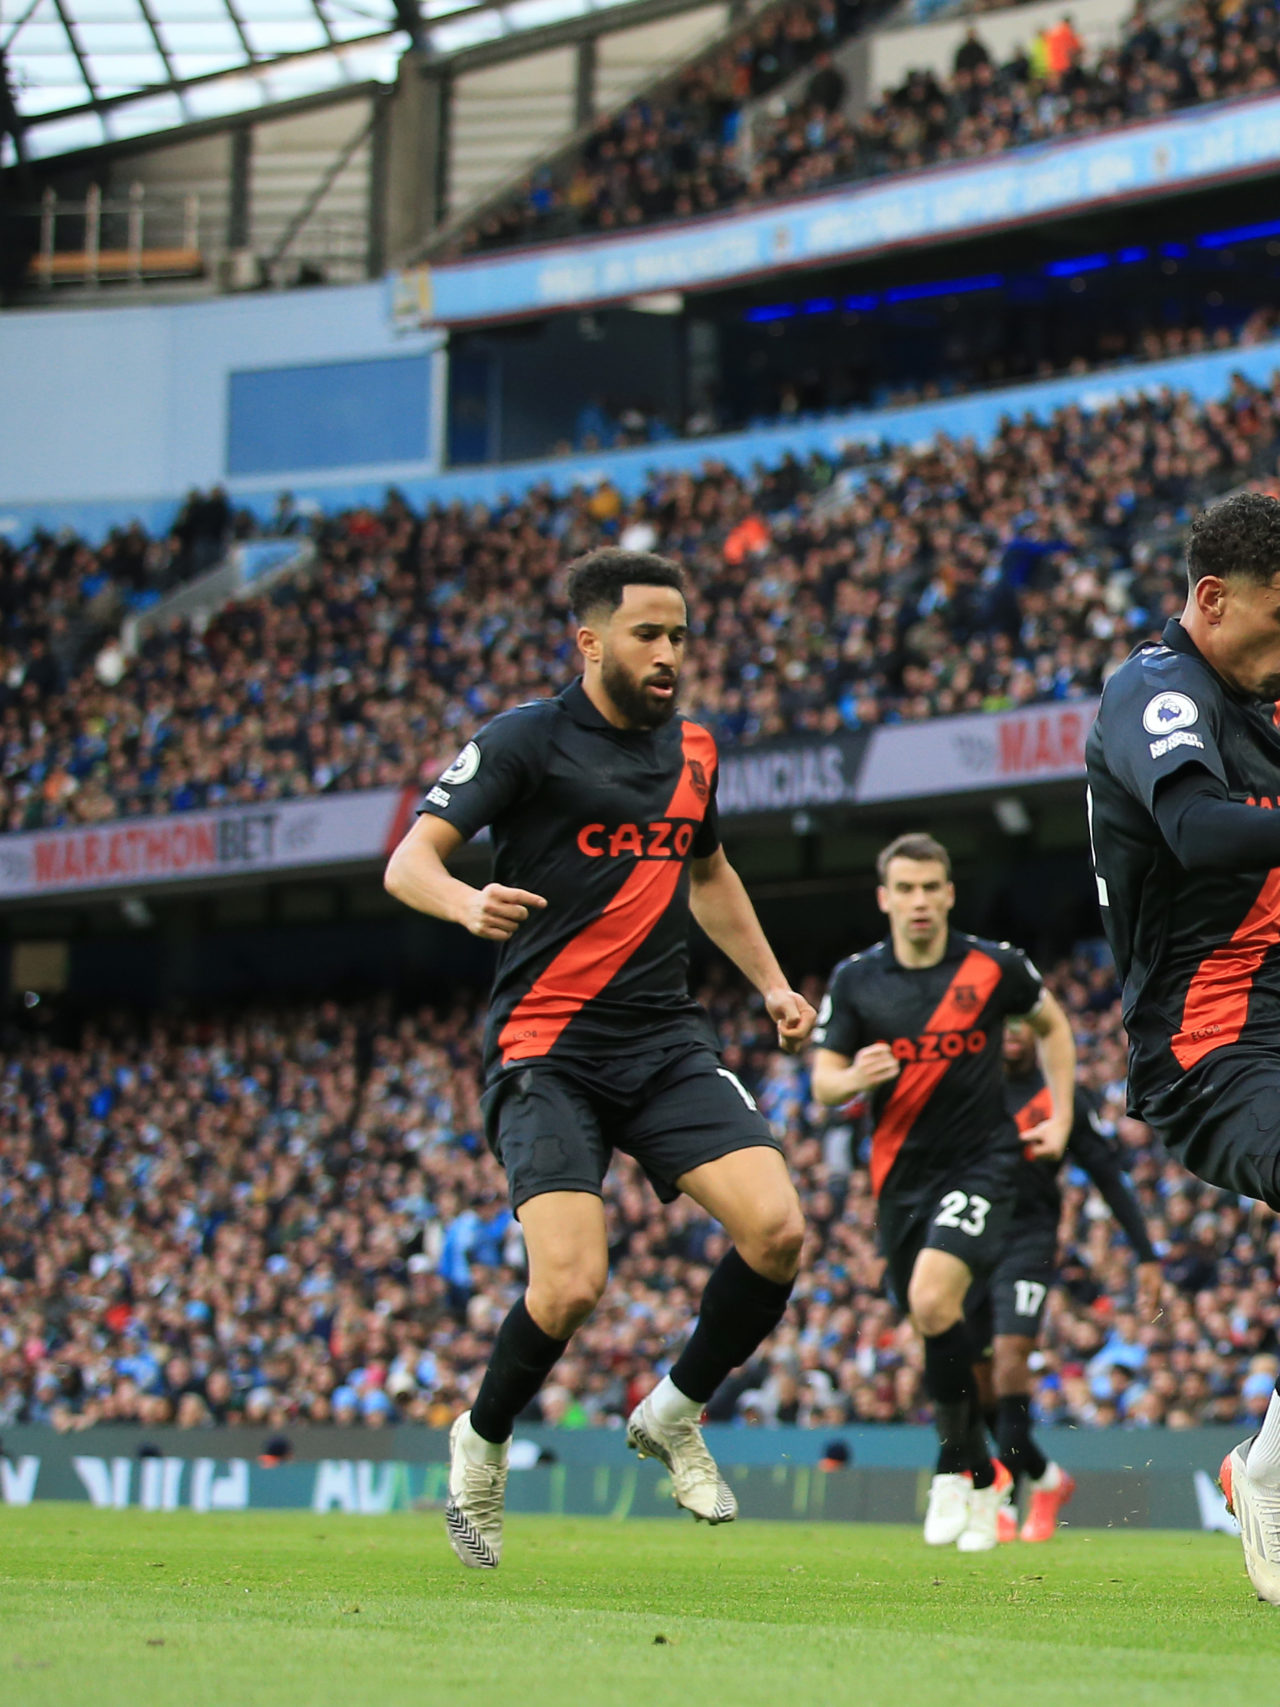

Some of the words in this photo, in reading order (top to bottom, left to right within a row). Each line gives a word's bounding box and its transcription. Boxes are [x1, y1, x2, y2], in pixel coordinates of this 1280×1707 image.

[998, 708, 1100, 773] MAR
[577, 822, 694, 857] CAZO
[874, 1030, 987, 1062] AZOO
[934, 1190, 991, 1237] 23
[1014, 1279, 1047, 1317] 17
